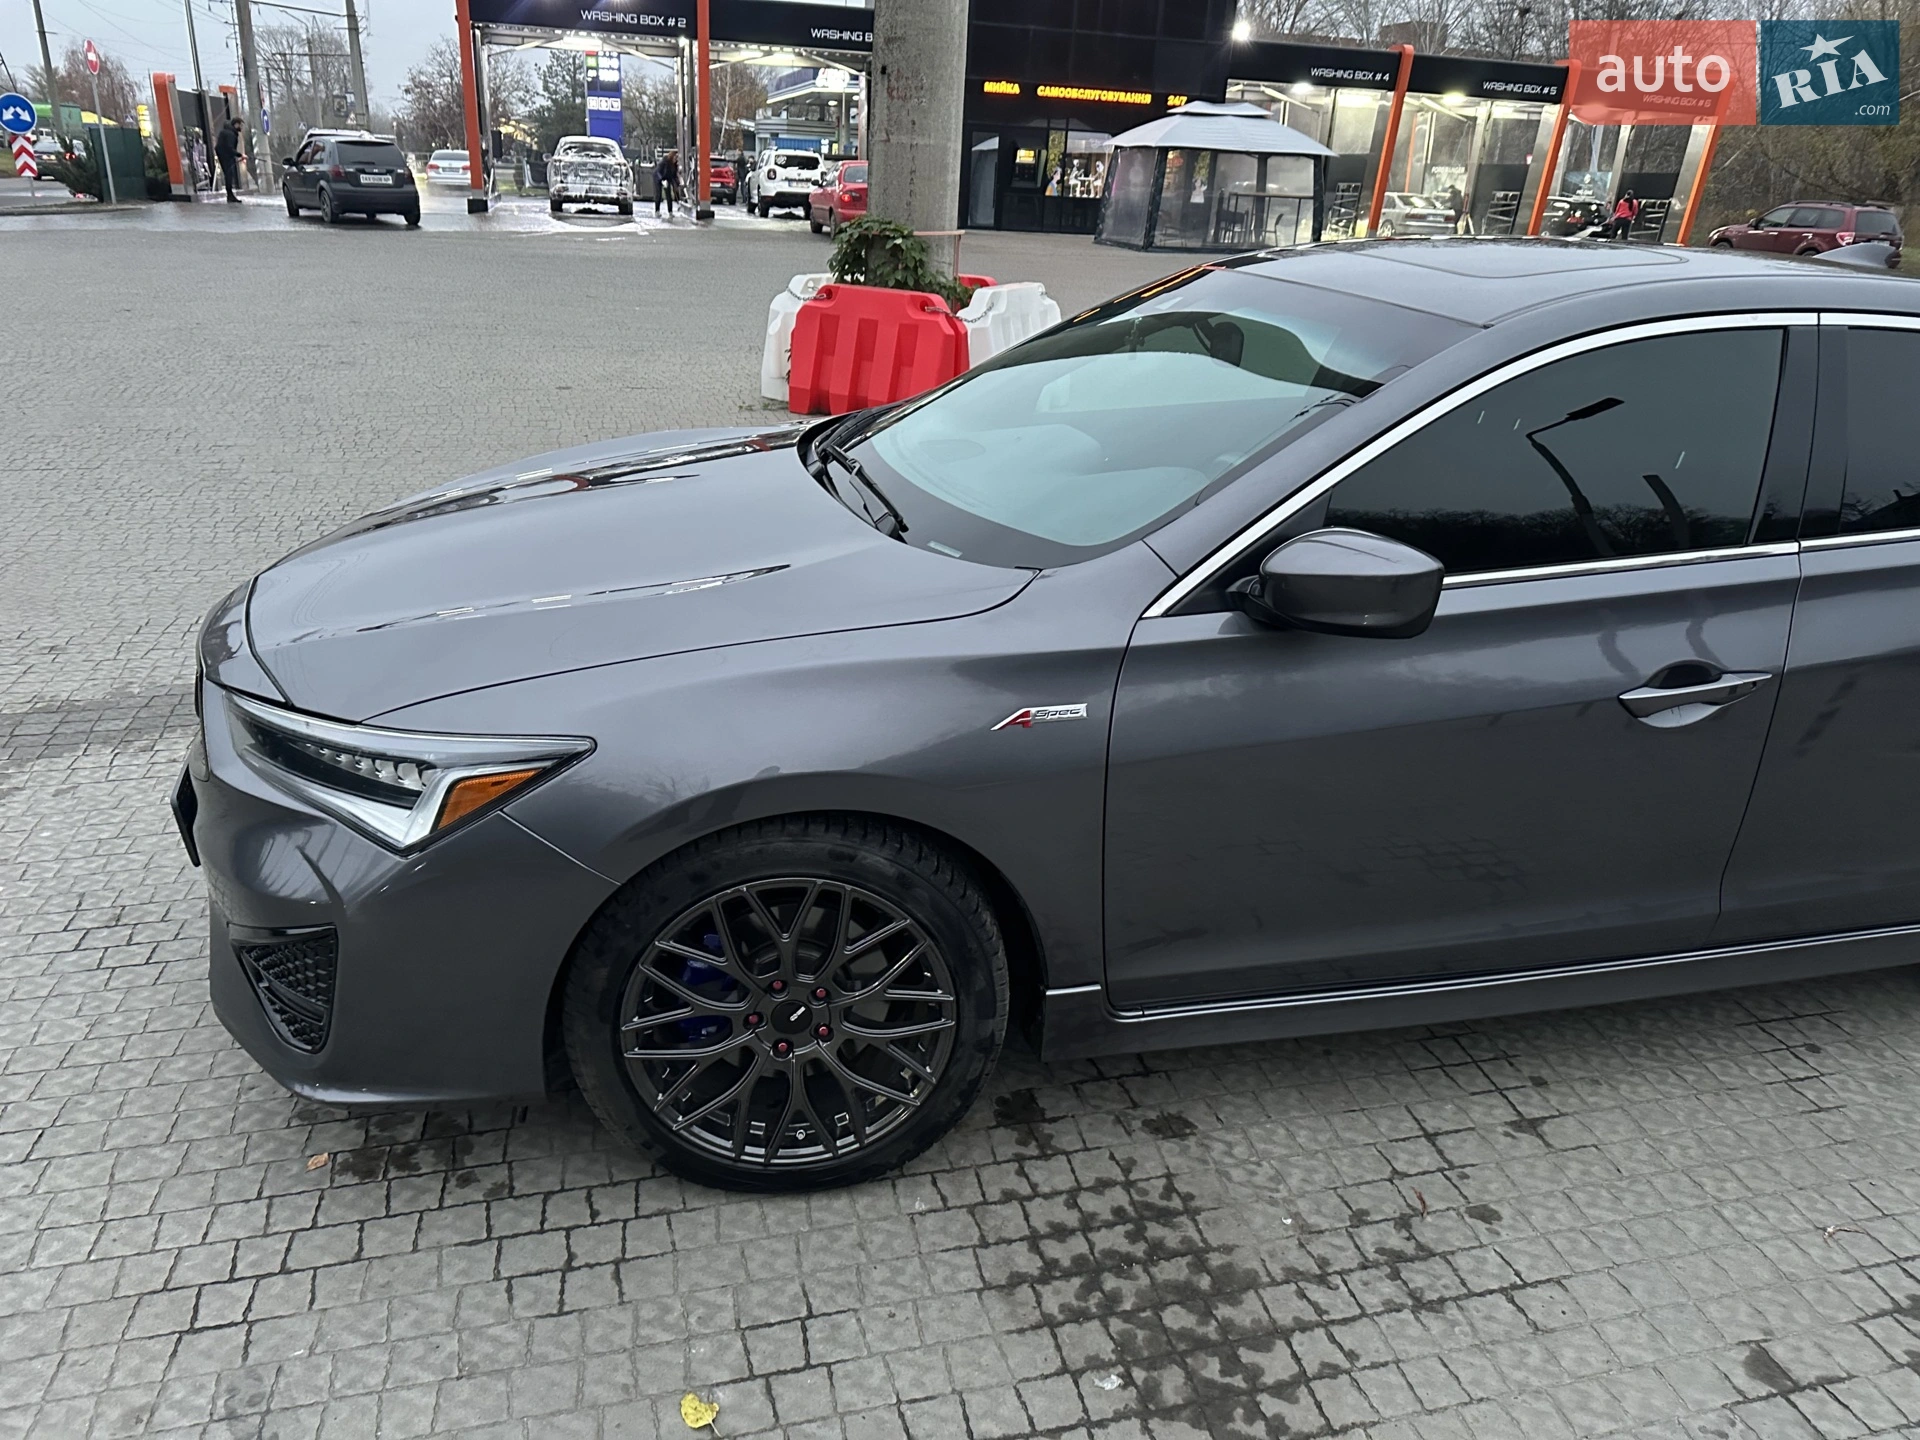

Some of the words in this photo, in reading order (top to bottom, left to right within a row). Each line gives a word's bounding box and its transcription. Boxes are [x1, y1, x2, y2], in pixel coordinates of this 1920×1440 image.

[581, 10, 637, 24] WASHING
[640, 14, 665, 26] BOX
[811, 28, 863, 41] WASHING
[1310, 67, 1354, 79] WASHING
[1354, 71, 1374, 80] BOX
[984, 81, 1020, 95] МИЙКА
[1483, 81, 1524, 93] WASHING
[1524, 84, 1542, 94] BOX
